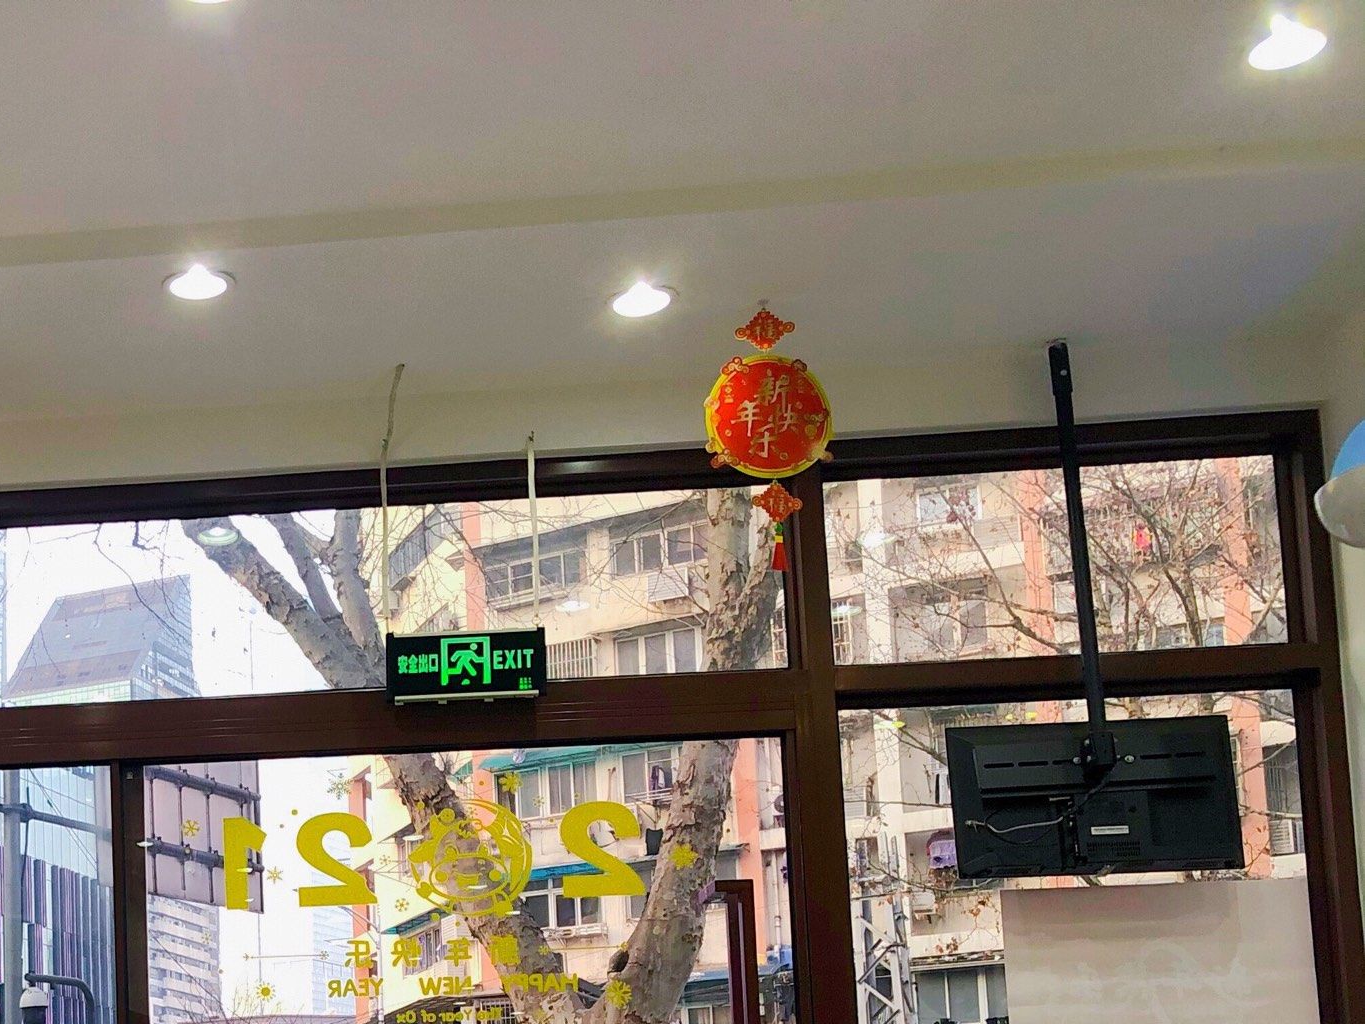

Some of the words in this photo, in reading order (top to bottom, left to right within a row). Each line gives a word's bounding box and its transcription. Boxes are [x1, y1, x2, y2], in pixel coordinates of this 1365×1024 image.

[397, 653, 439, 674] 安全出口
[492, 648, 534, 670] EXIT
